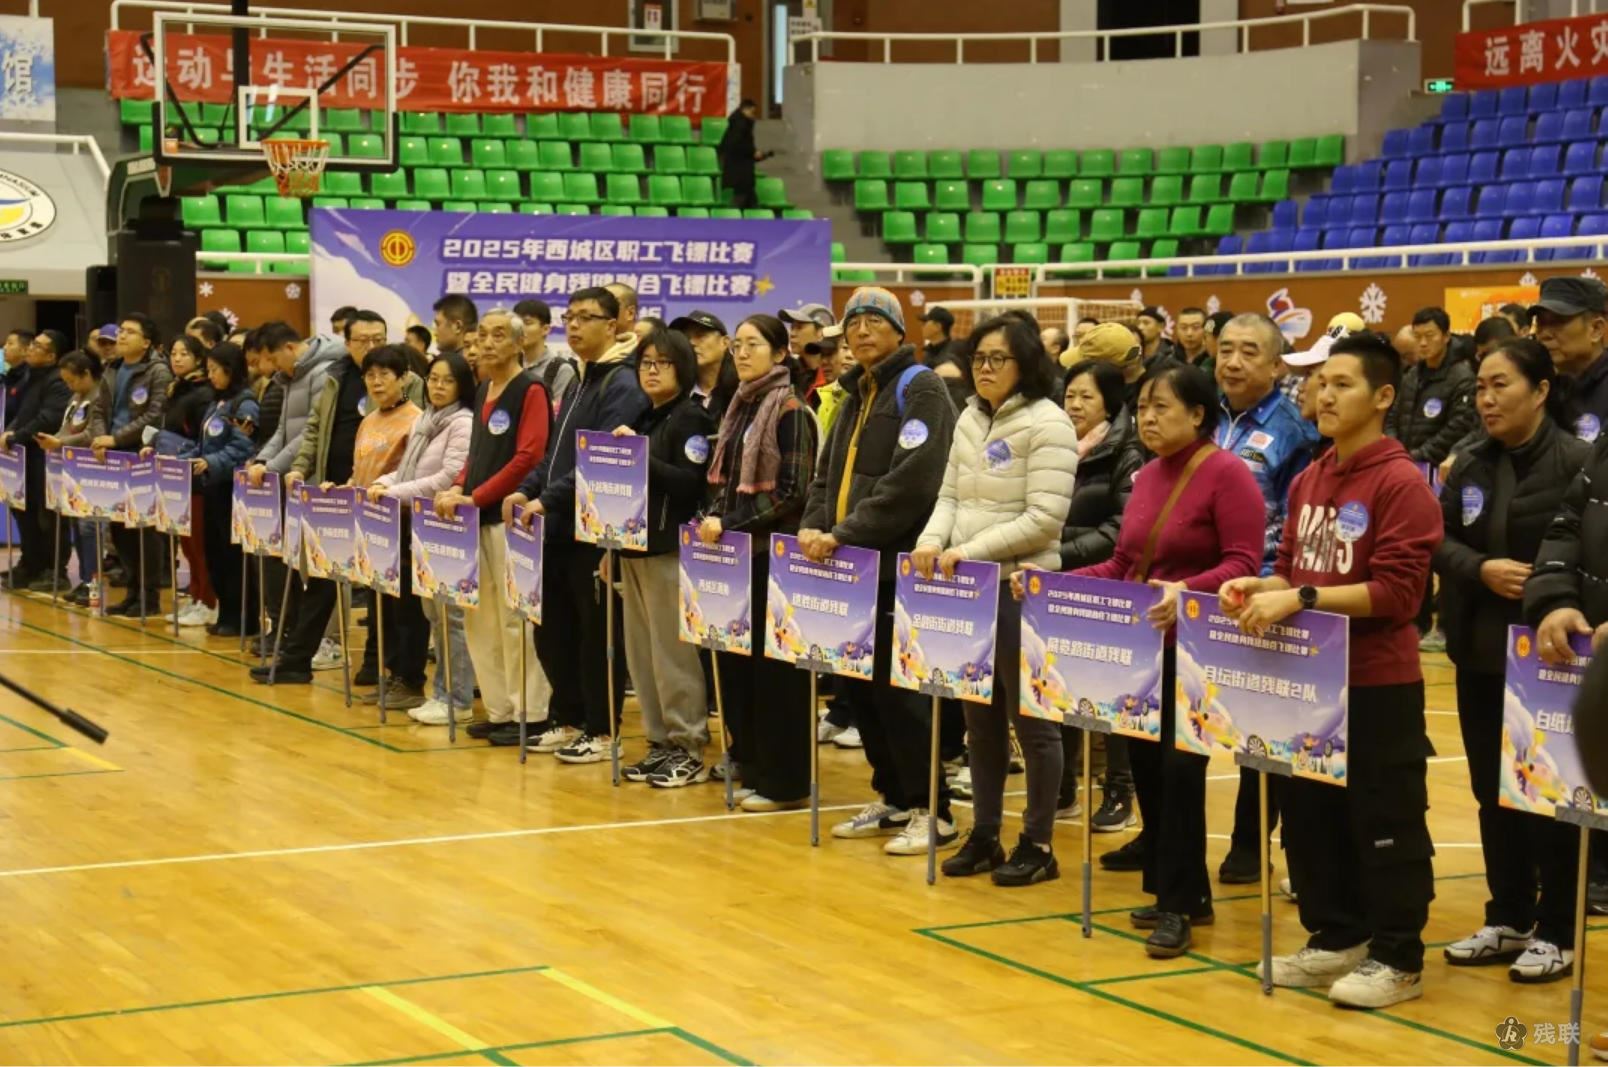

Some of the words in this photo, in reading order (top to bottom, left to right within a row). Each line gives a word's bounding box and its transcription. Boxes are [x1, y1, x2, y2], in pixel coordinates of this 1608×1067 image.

[448, 61, 706, 113] 你我和健康同行
[443, 238, 755, 264] 2025年西城区职工飞镖比赛
